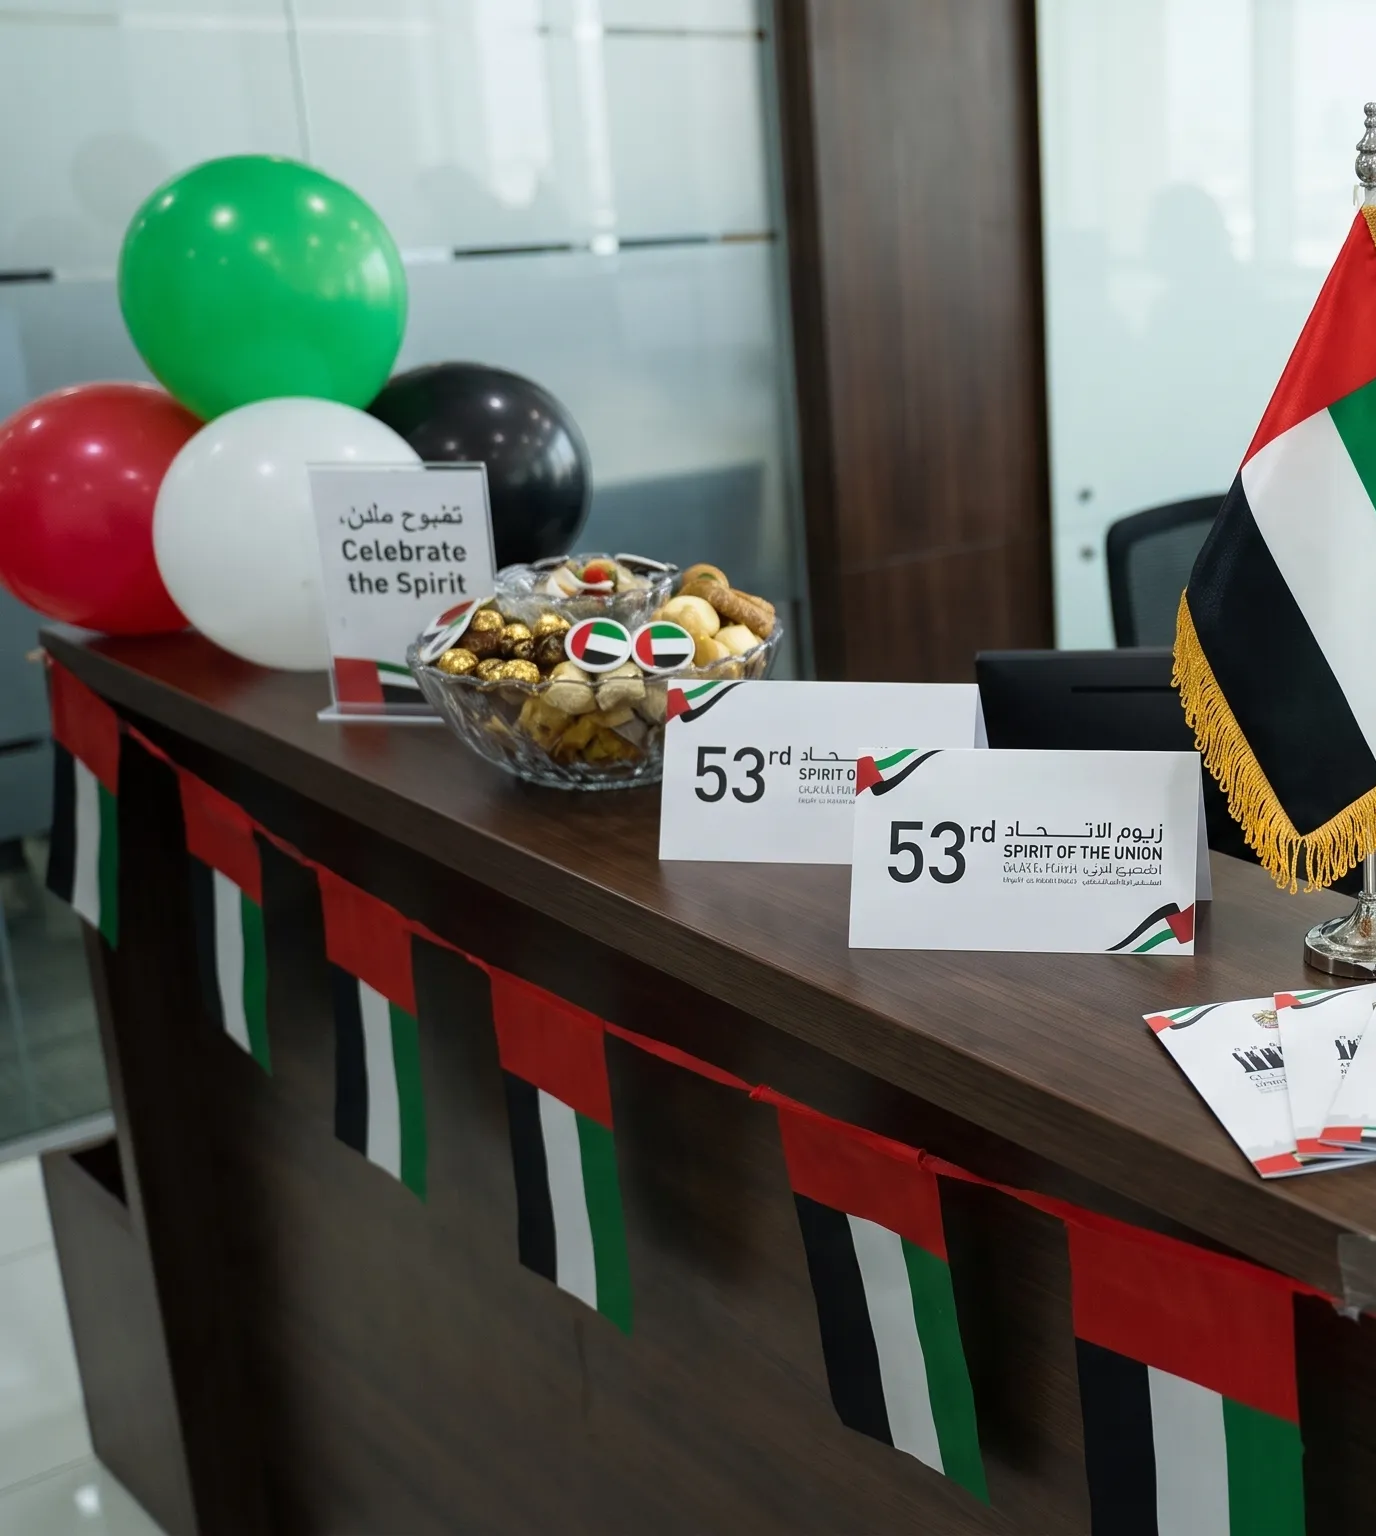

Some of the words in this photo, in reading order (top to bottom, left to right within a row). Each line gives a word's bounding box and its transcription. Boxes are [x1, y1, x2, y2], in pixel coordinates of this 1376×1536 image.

[342, 539, 467, 562] Celebrate
[349, 572, 388, 594] the
[397, 572, 467, 598] Spirit
[799, 768, 843, 780] SPIRIT
[1003, 845, 1053, 859] SPIRIT
[1056, 845, 1077, 859] OF
[1080, 846, 1110, 859] THE
[1114, 847, 1162, 860] UNION
